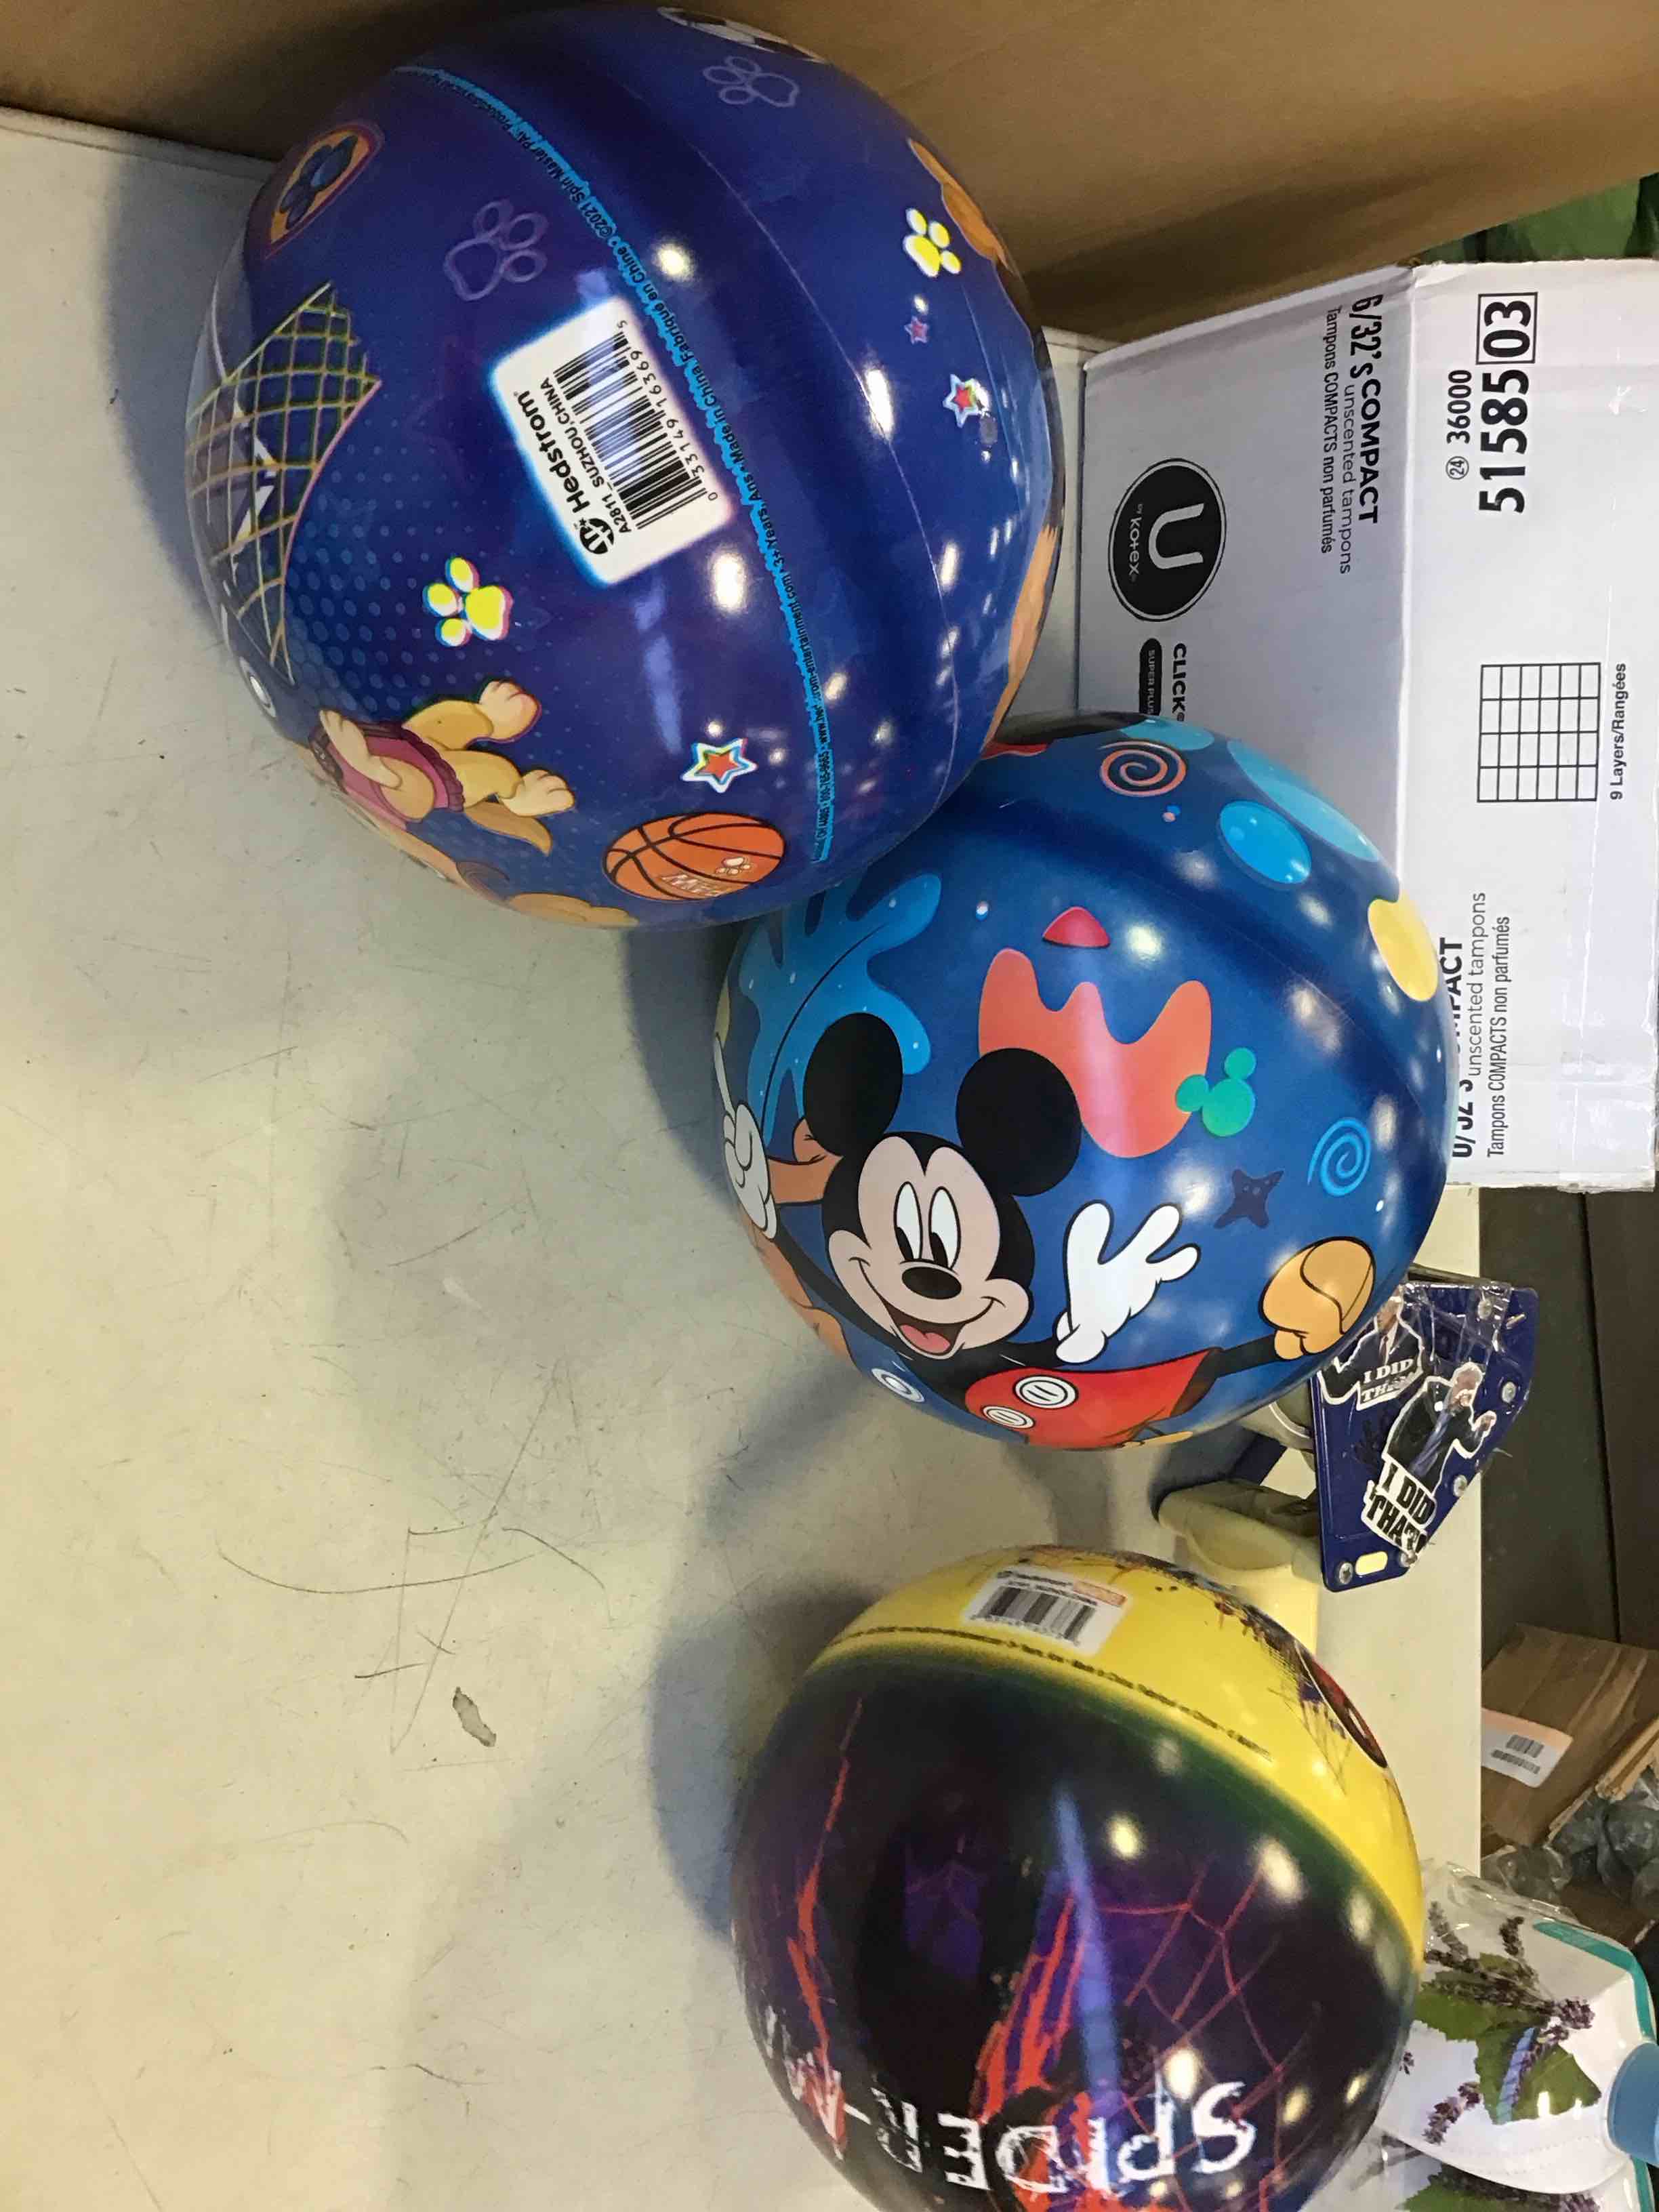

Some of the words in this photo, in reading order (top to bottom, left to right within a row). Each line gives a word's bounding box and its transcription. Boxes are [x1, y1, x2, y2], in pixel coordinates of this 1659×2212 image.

[562, 178, 587, 203] Spin
[617, 245, 644, 284] Chine
[643, 283, 658, 301] en
[1323, 305, 1343, 370] Tampons
[1483, 300, 1531, 358] 03
[630, 350, 668, 408] 16369
[1446, 369, 1472, 444] 36000
[714, 405, 729, 424] in
[721, 422, 745, 465] Made
[1323, 373, 1338, 453] COMPACTS
[1343, 384, 1356, 483] unscented
[1479, 369, 1529, 513] 51585
[517, 390, 591, 514] Hedstrom
[666, 418, 705, 477] 33149
[1322, 455, 1334, 483] non
[1358, 378, 1381, 524] COMPACT
[1448, 458, 1467, 477] 24
[708, 491, 718, 501] 0
[744, 473, 762, 502] Ans
[1149, 503, 1204, 569] U
[1320, 486, 1336, 554] parfumés
[1338, 489, 1355, 574] tampons
[1609, 663, 1629, 787] Layers/Rangées
[1610, 790, 1623, 800] 9
[1468, 892, 1489, 977] tampons
[1492, 916, 1512, 983] parfumés
[1467, 982, 1484, 1077] unscented
[1492, 986, 1507, 1014] non
[1488, 1017, 1507, 1091] COMPACTS
[1487, 1094, 1509, 1158] Tampons
[1364, 1369, 1373, 1386] I
[1374, 1358, 1414, 1380] DID
[1382, 1462, 1398, 1492] I
[1396, 1476, 1435, 1525] DID
